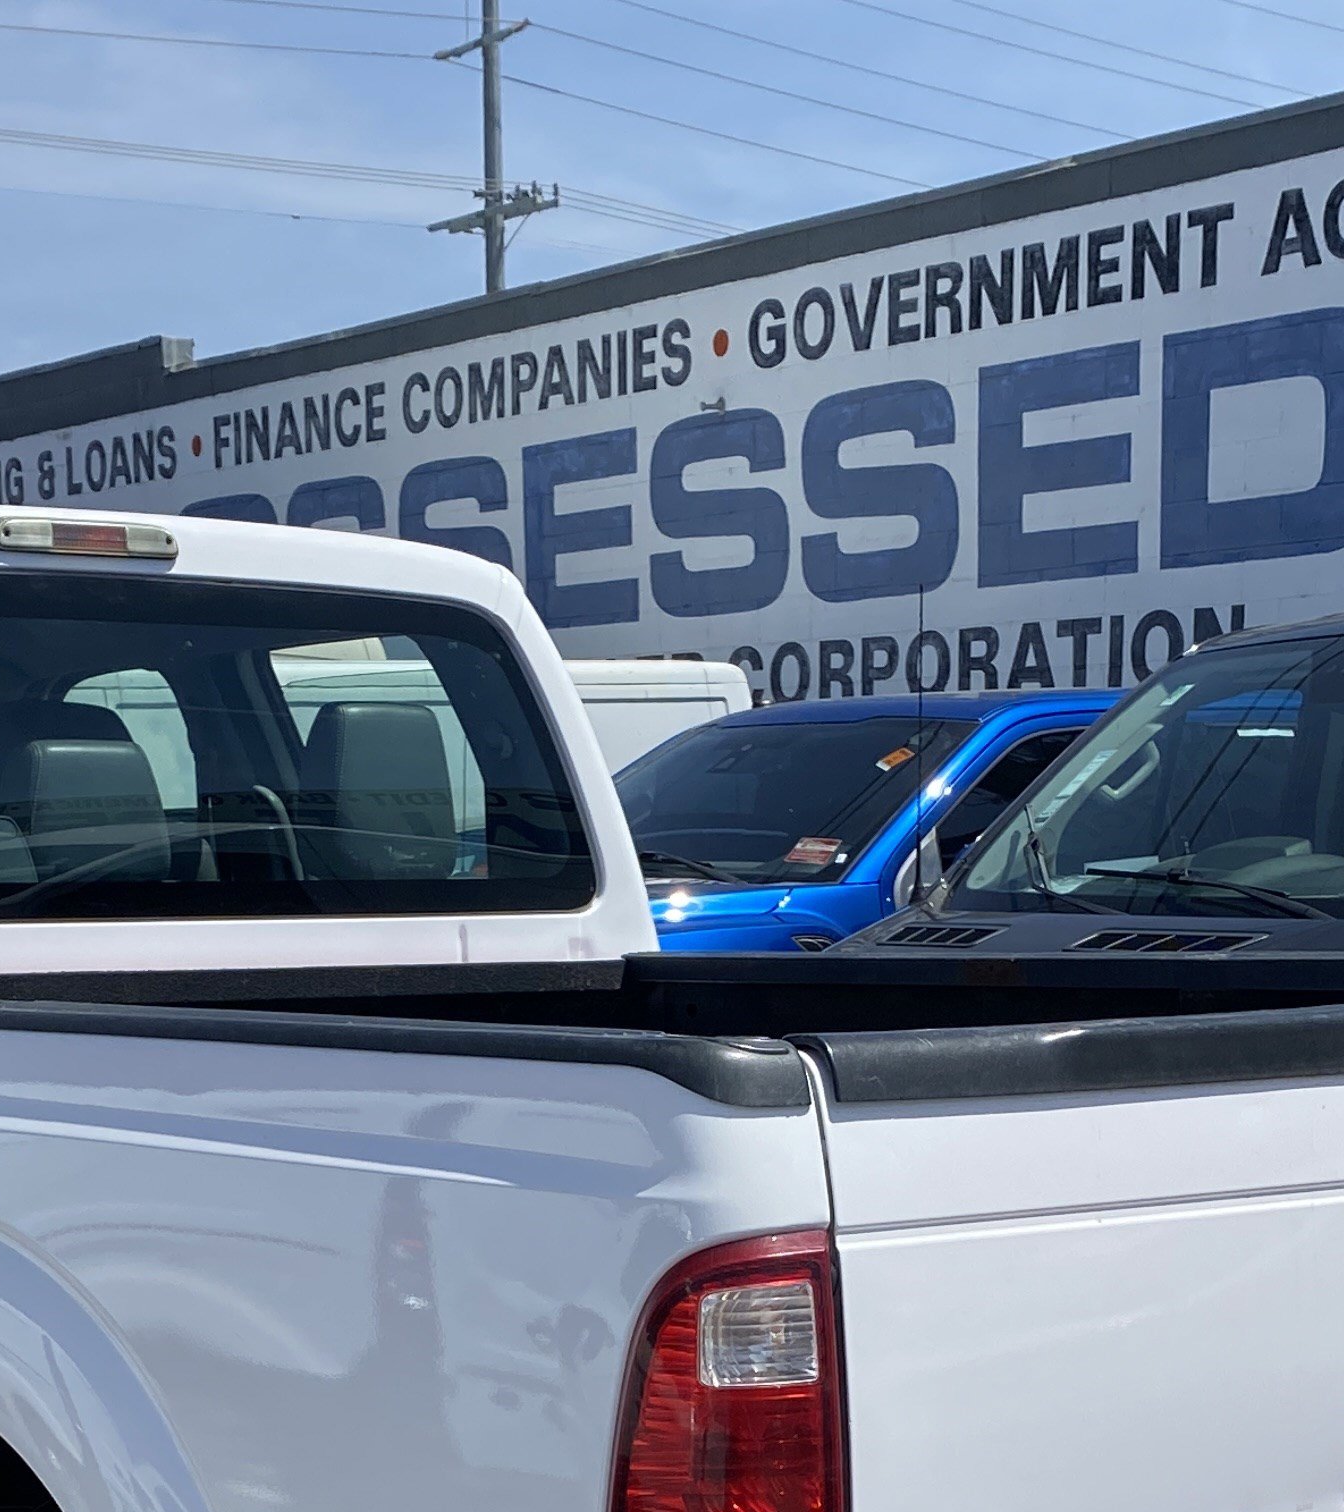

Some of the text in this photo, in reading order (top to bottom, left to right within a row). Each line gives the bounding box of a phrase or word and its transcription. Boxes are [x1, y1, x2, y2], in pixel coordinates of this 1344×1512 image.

[37, 449, 57, 501] &
[66, 424, 178, 496] LOANS
[212, 381, 387, 470] FINANCE
[402, 318, 692, 434] COMPANIES
[748, 203, 1236, 369] GOVERNMENT
